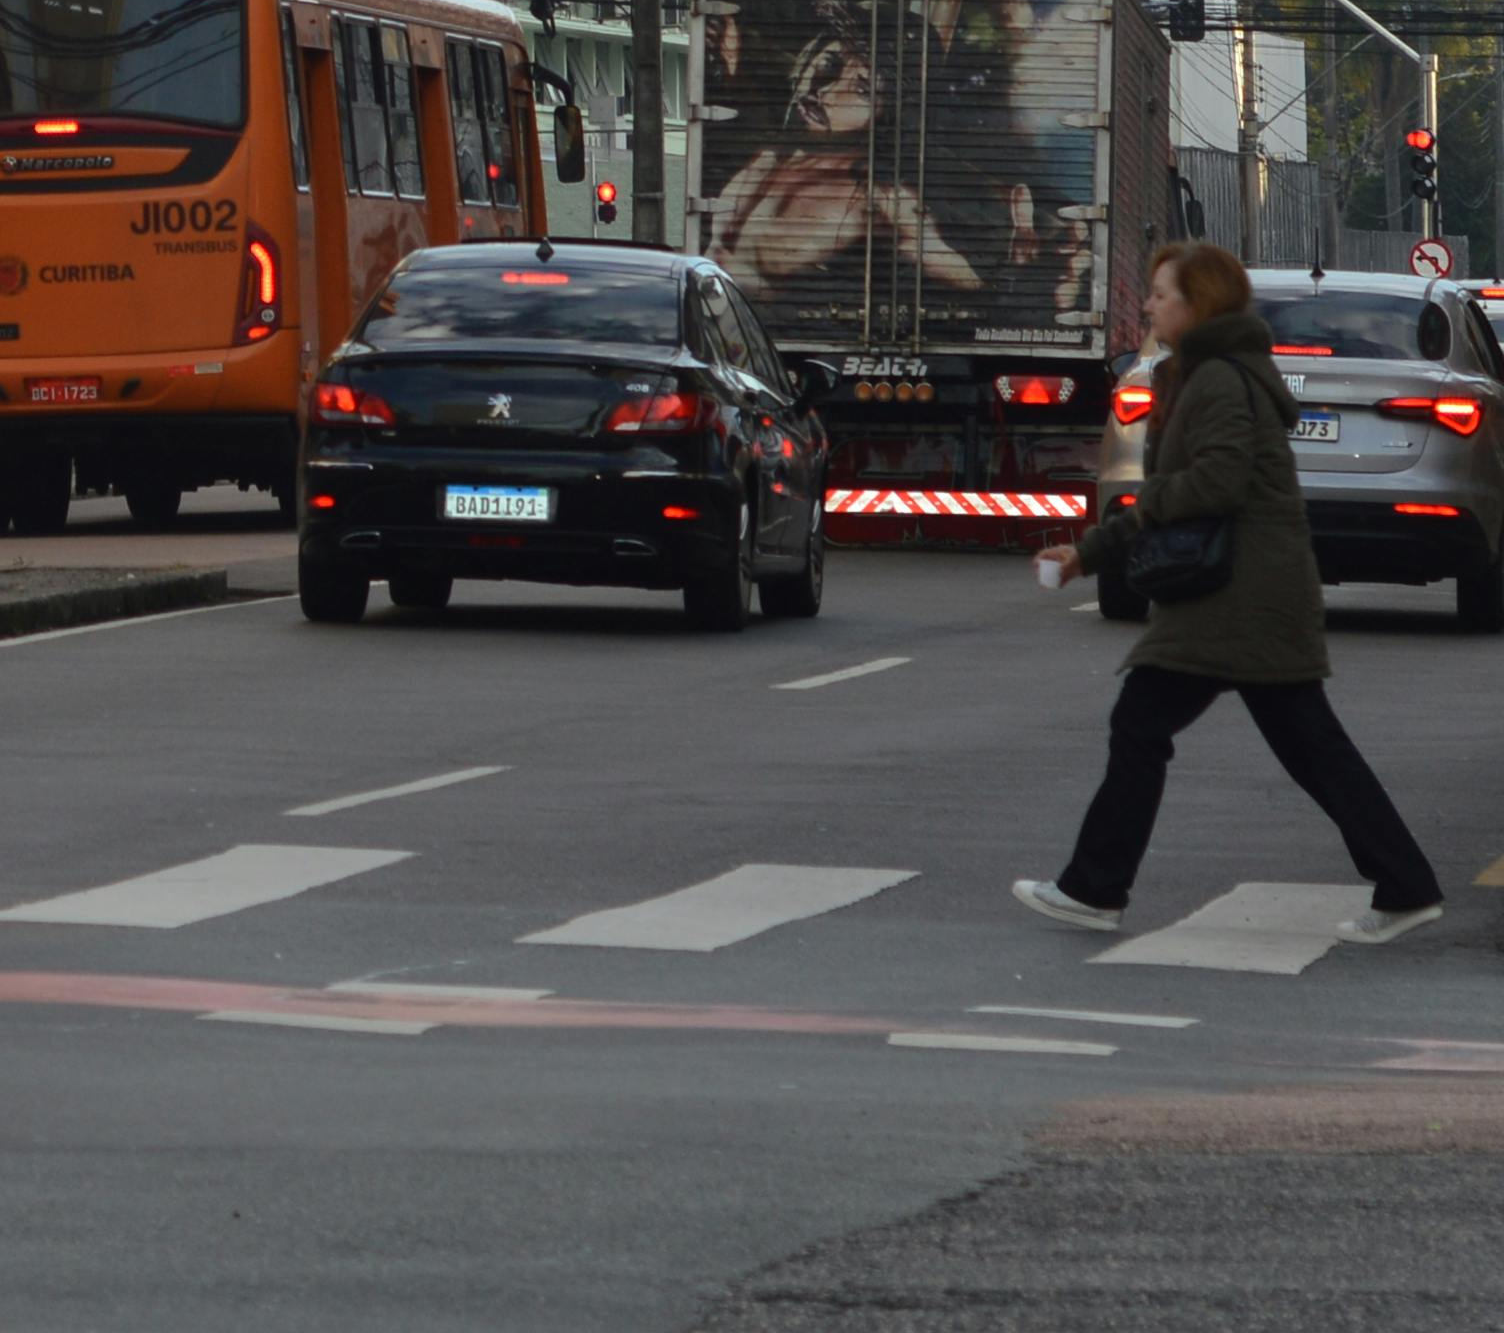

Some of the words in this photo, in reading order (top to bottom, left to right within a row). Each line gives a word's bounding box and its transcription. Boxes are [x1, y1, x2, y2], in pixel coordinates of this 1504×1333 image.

[20, 156, 113, 170] Marcopolo
[154, 240, 238, 255] TRANSBUS
[39, 264, 135, 284] CURITIBA
[626, 384, 651, 393] 408
